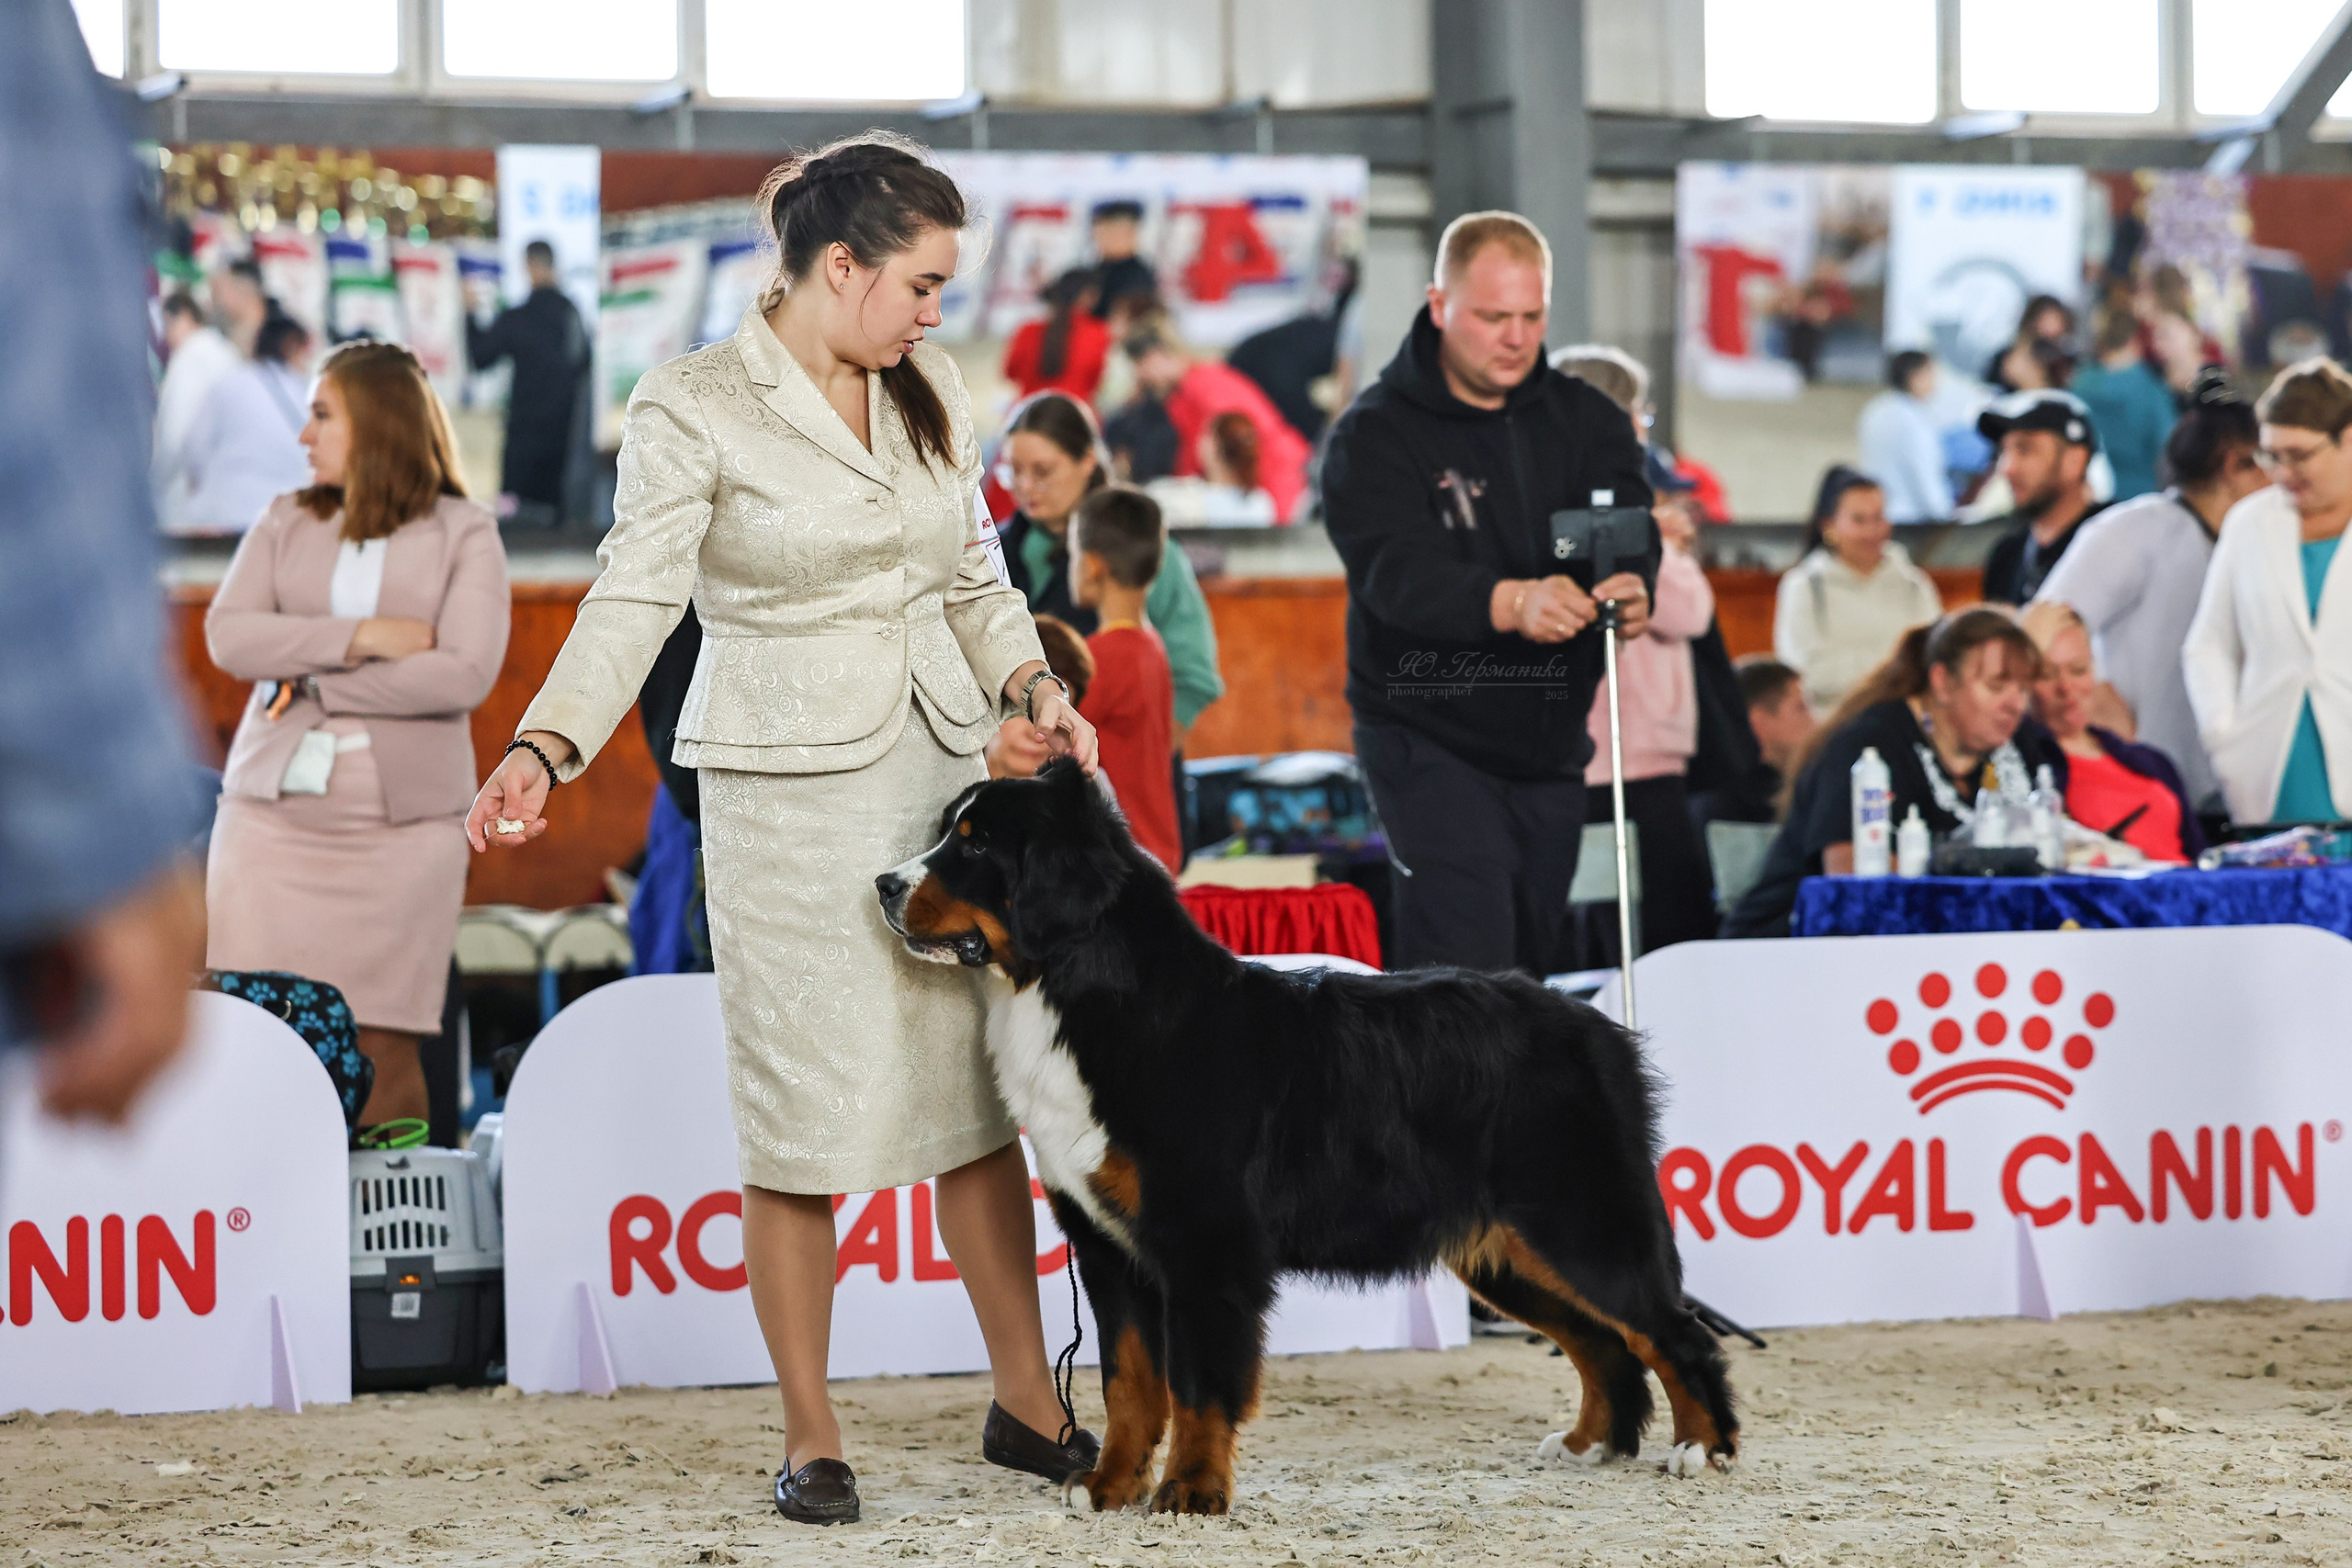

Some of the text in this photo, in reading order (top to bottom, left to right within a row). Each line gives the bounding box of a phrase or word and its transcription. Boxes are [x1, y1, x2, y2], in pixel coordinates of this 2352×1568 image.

[609, 1178, 961, 1297] ROAL
[1657, 1121, 2316, 1241] ROYAL CANIN
[0, 1208, 217, 1326] NIN
